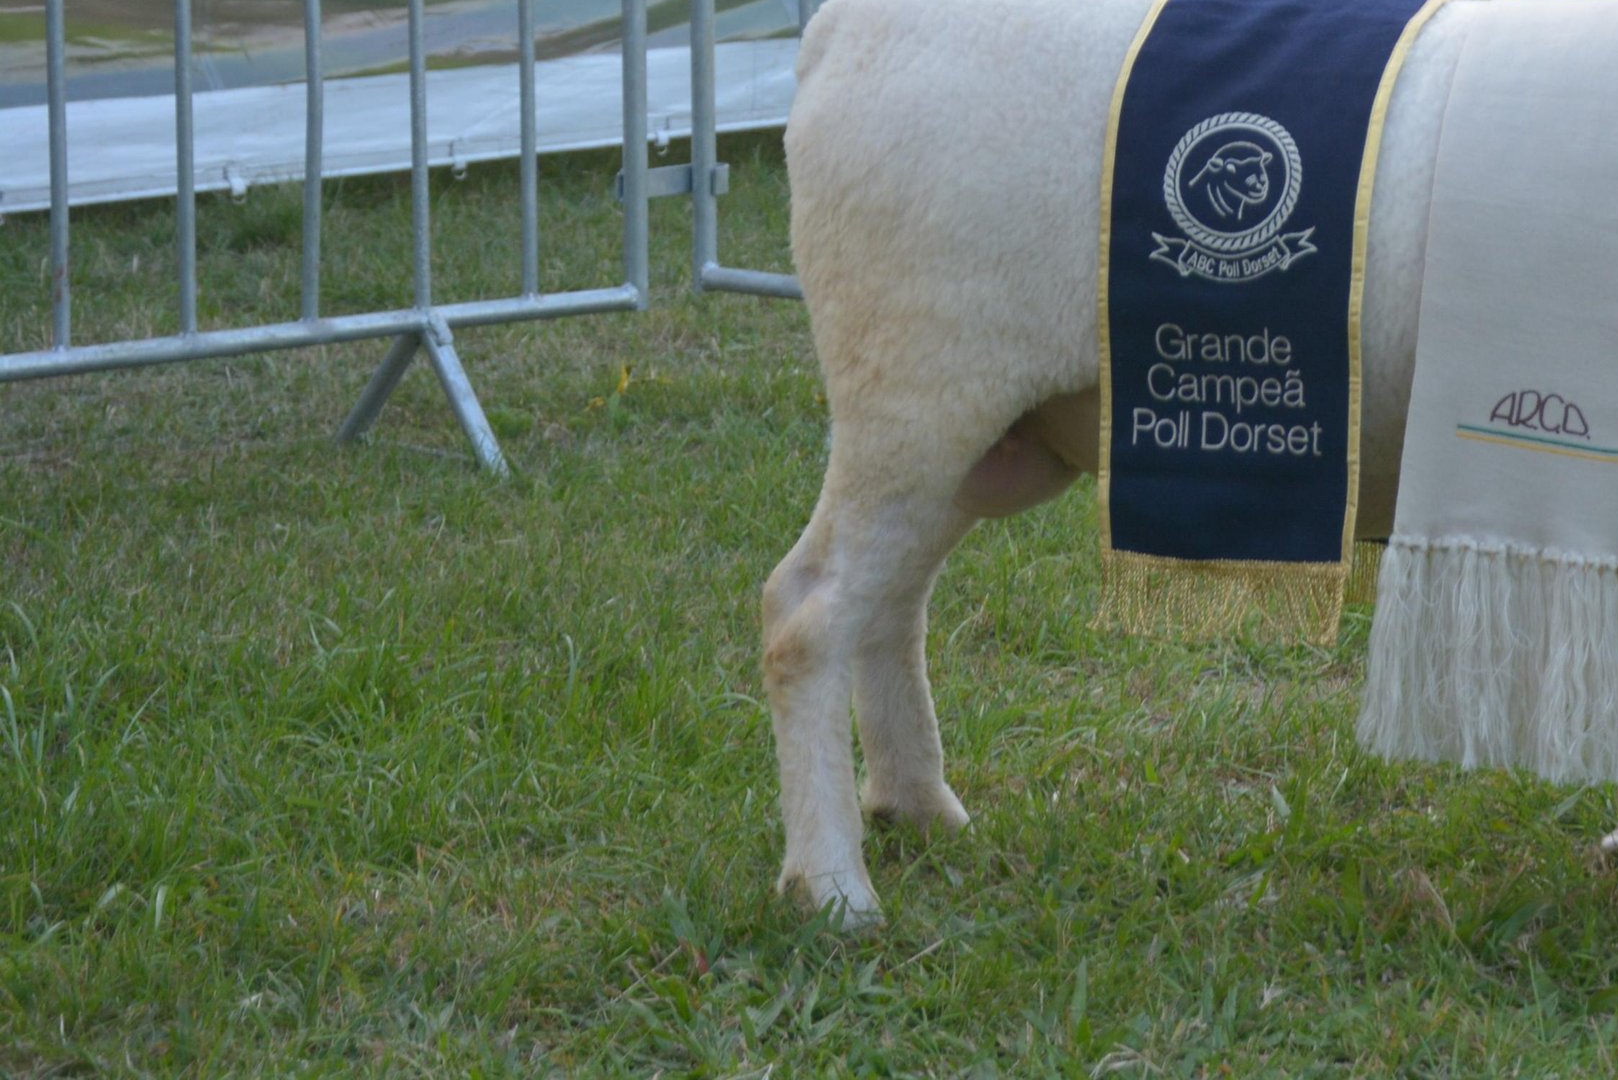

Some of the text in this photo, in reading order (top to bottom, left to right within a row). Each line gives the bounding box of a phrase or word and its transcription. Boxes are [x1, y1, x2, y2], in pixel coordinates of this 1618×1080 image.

[1187, 246, 1281, 277] ABC Poll Dorset
[1155, 323, 1292, 365] Grande
[1147, 363, 1306, 413] Campeã
[1132, 407, 1322, 456] Poll Dorset
